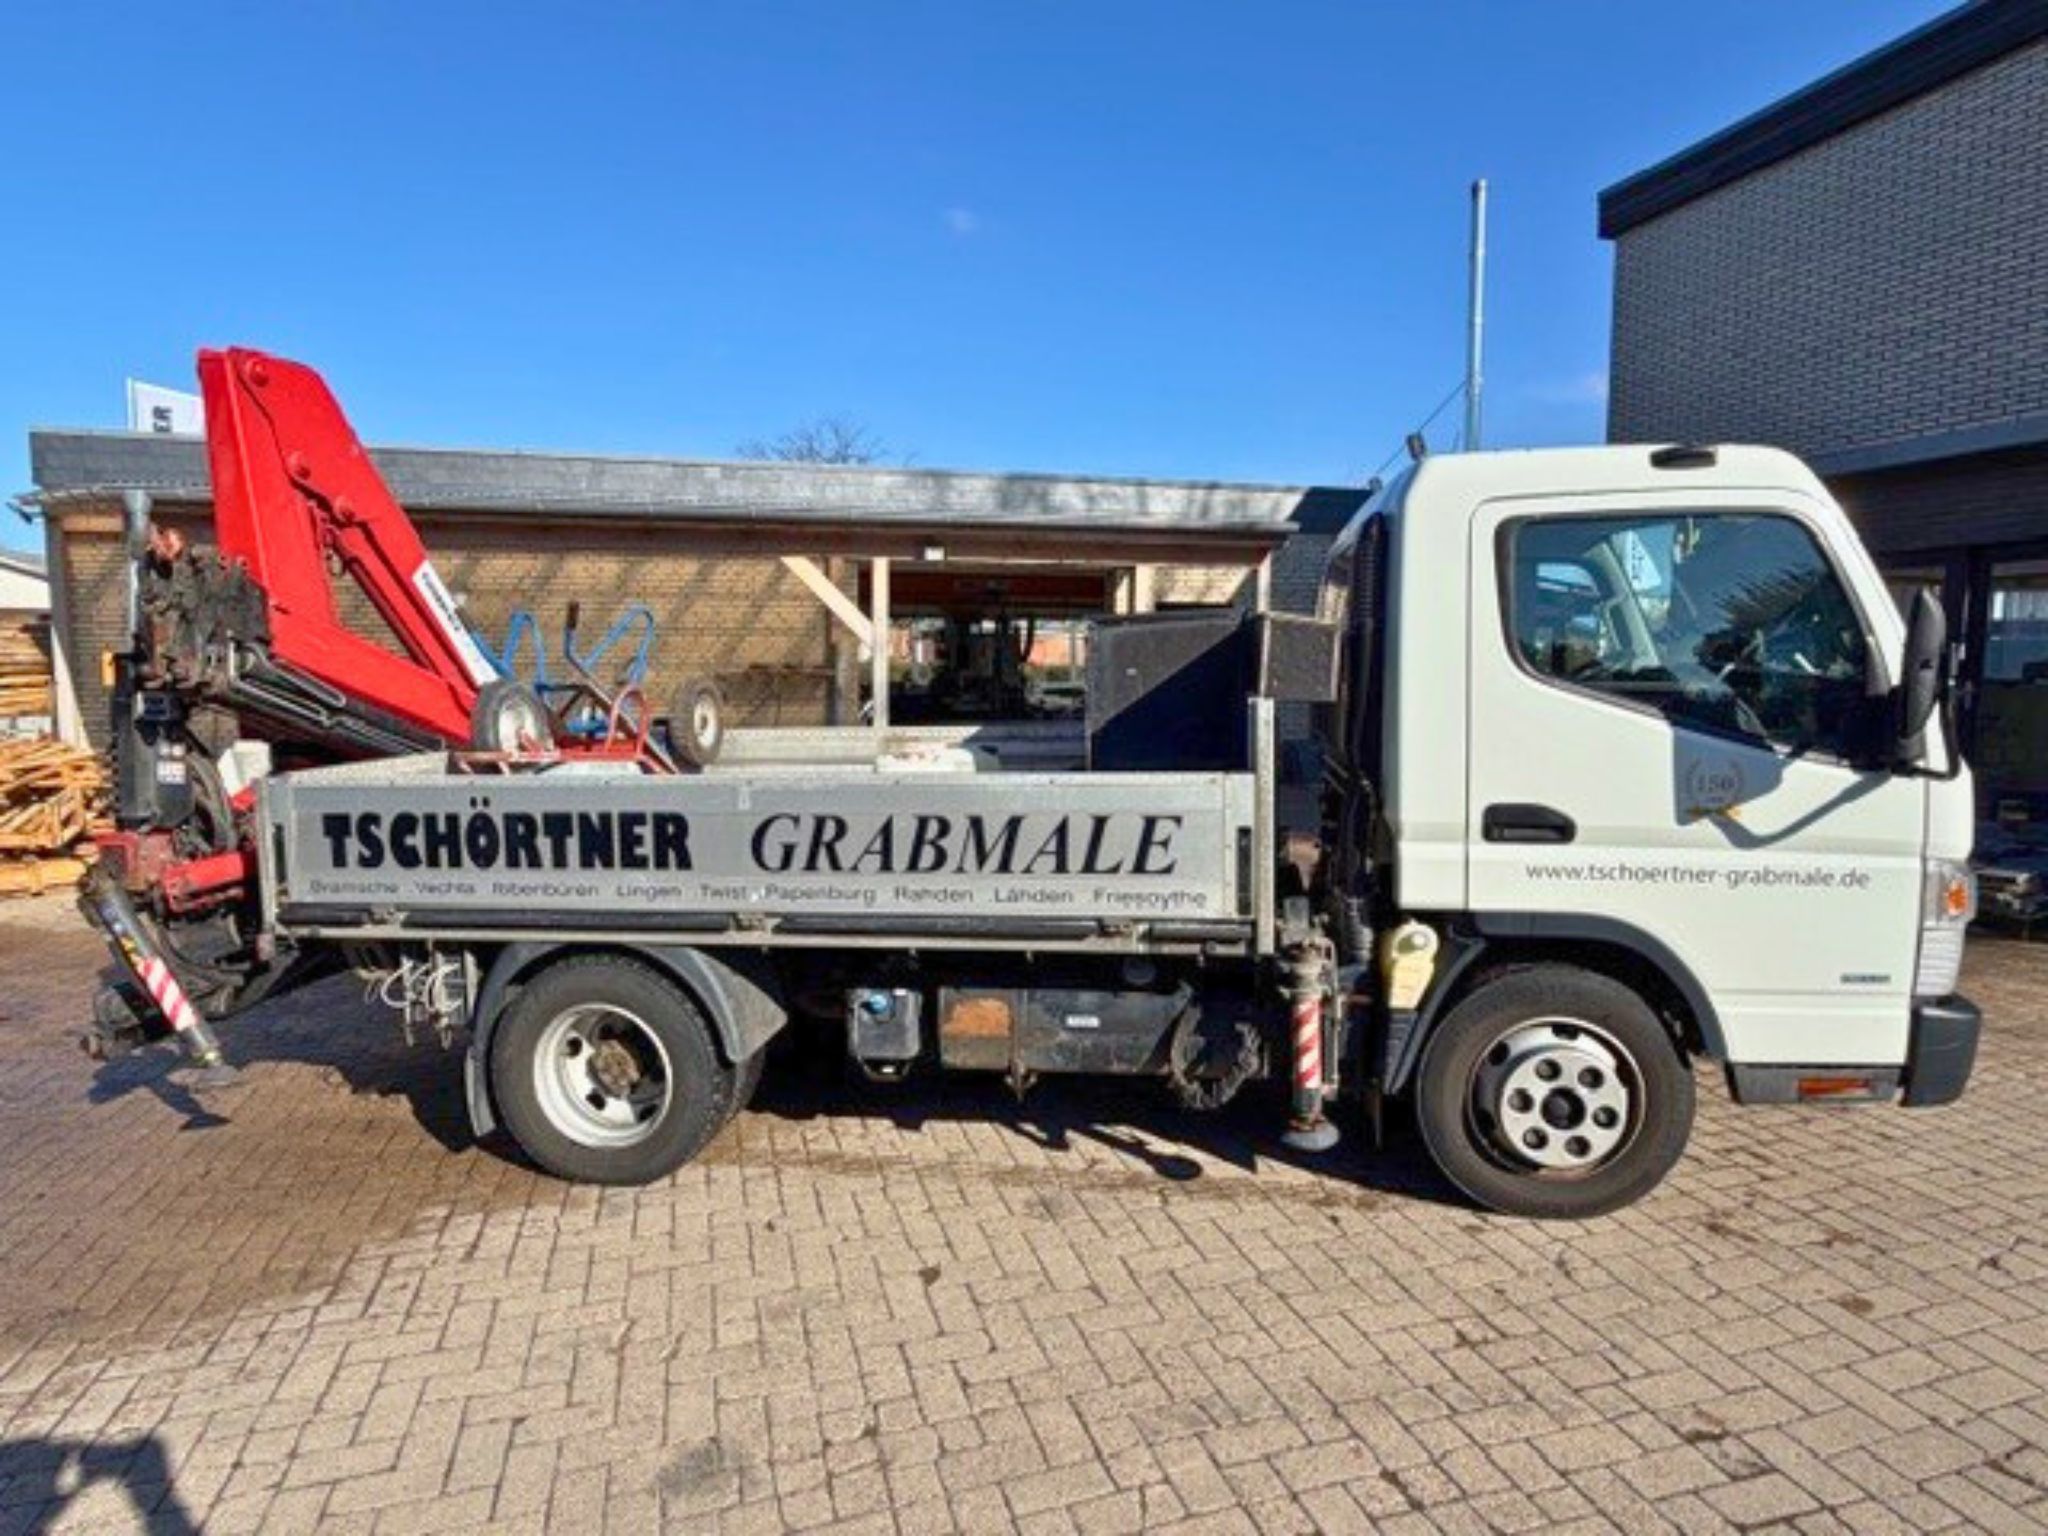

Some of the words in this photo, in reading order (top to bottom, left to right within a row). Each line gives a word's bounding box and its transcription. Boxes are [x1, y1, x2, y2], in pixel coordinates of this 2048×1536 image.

[322, 796, 693, 871] TSCHÖRTNER
[750, 812, 1183, 876] GRABMALE
[1525, 862, 1871, 890] www.tschoertner-grabmale.de
[413, 879, 476, 896] Vechta
[616, 883, 683, 903] Lingen
[700, 882, 748, 901] Twist
[763, 882, 877, 907] Papenburg
